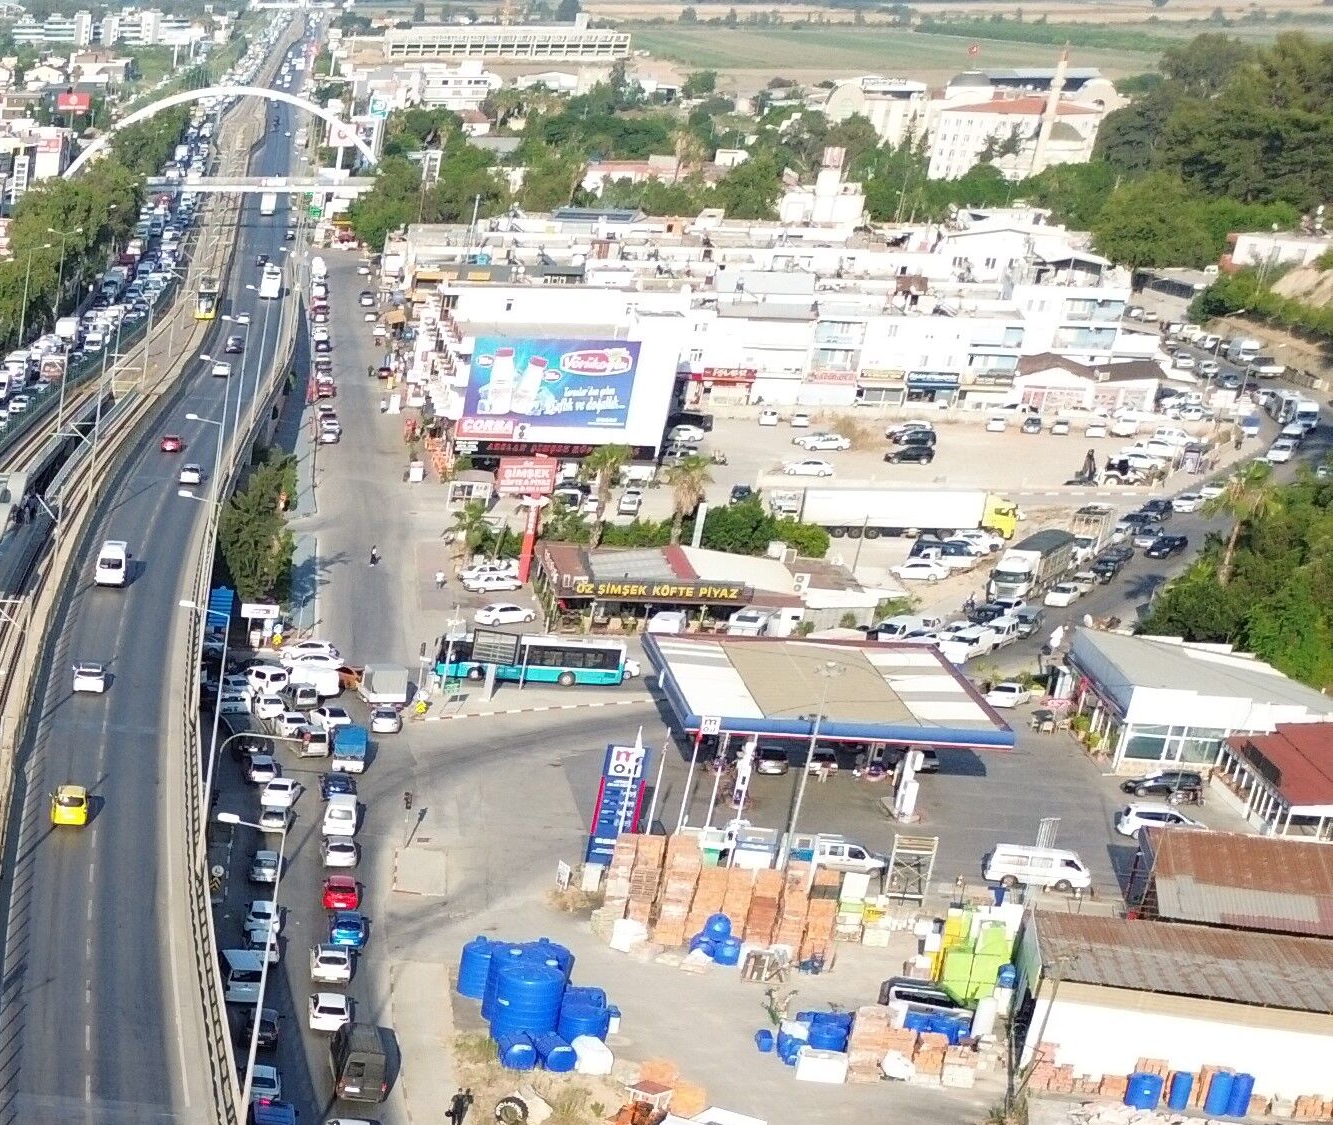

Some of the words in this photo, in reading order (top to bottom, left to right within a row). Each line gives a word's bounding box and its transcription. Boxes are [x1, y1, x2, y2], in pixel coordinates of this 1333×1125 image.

[576, 581, 595, 594] ÖZ
[597, 582, 647, 597] ŞİMŞEK
[652, 584, 695, 598] KÖFTE
[699, 586, 739, 599] PİYAZ
